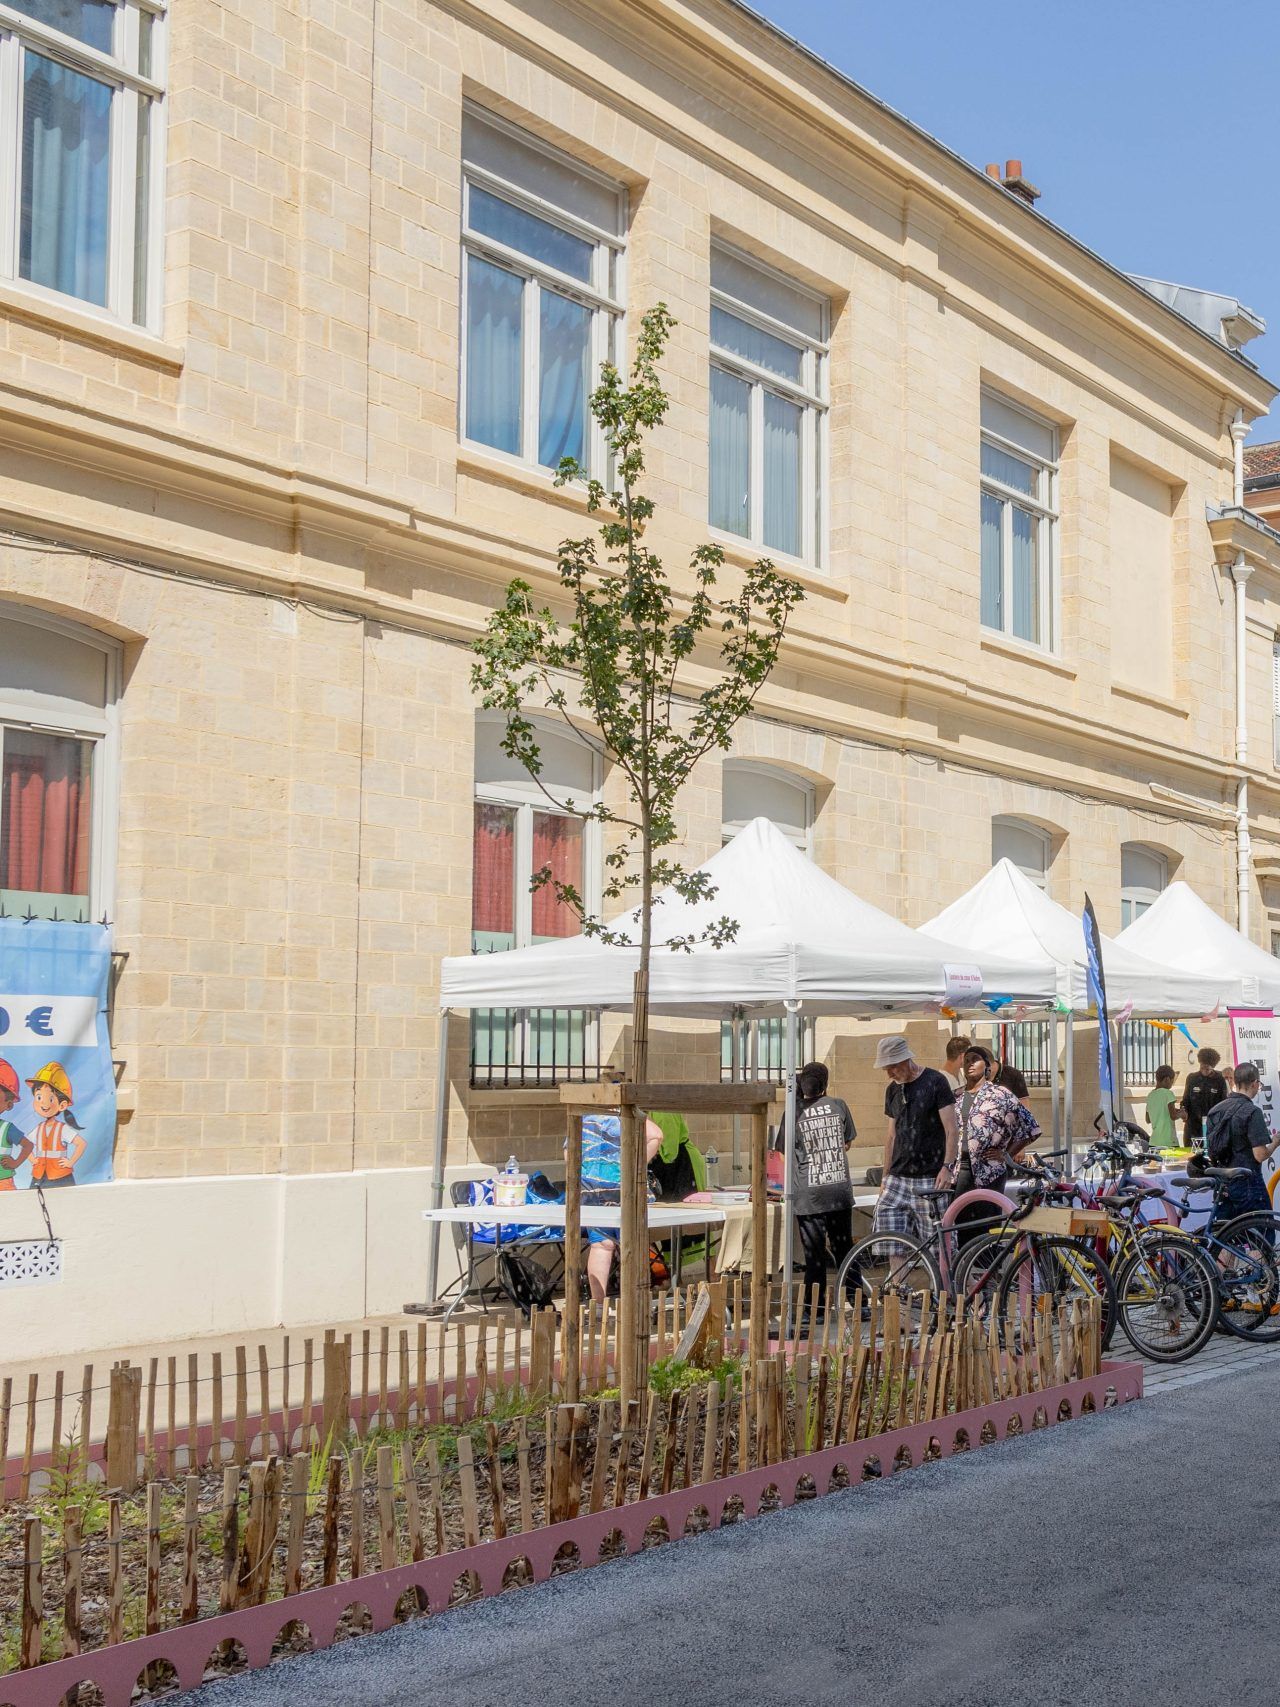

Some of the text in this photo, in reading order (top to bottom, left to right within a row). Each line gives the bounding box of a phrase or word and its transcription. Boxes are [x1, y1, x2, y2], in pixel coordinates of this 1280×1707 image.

[1238, 1026, 1272, 1039] Bienvenue
[803, 1104, 832, 1118] YASS
[799, 1115, 841, 1132] LA BANLIEUE
[1261, 1085, 1276, 1172] Plaie
[803, 1126, 842, 1142] INFLUENCE
[804, 1135, 842, 1153] PANAME
[808, 1160, 845, 1174] INFLUENCE
[808, 1170, 847, 1185] LE MONDE
